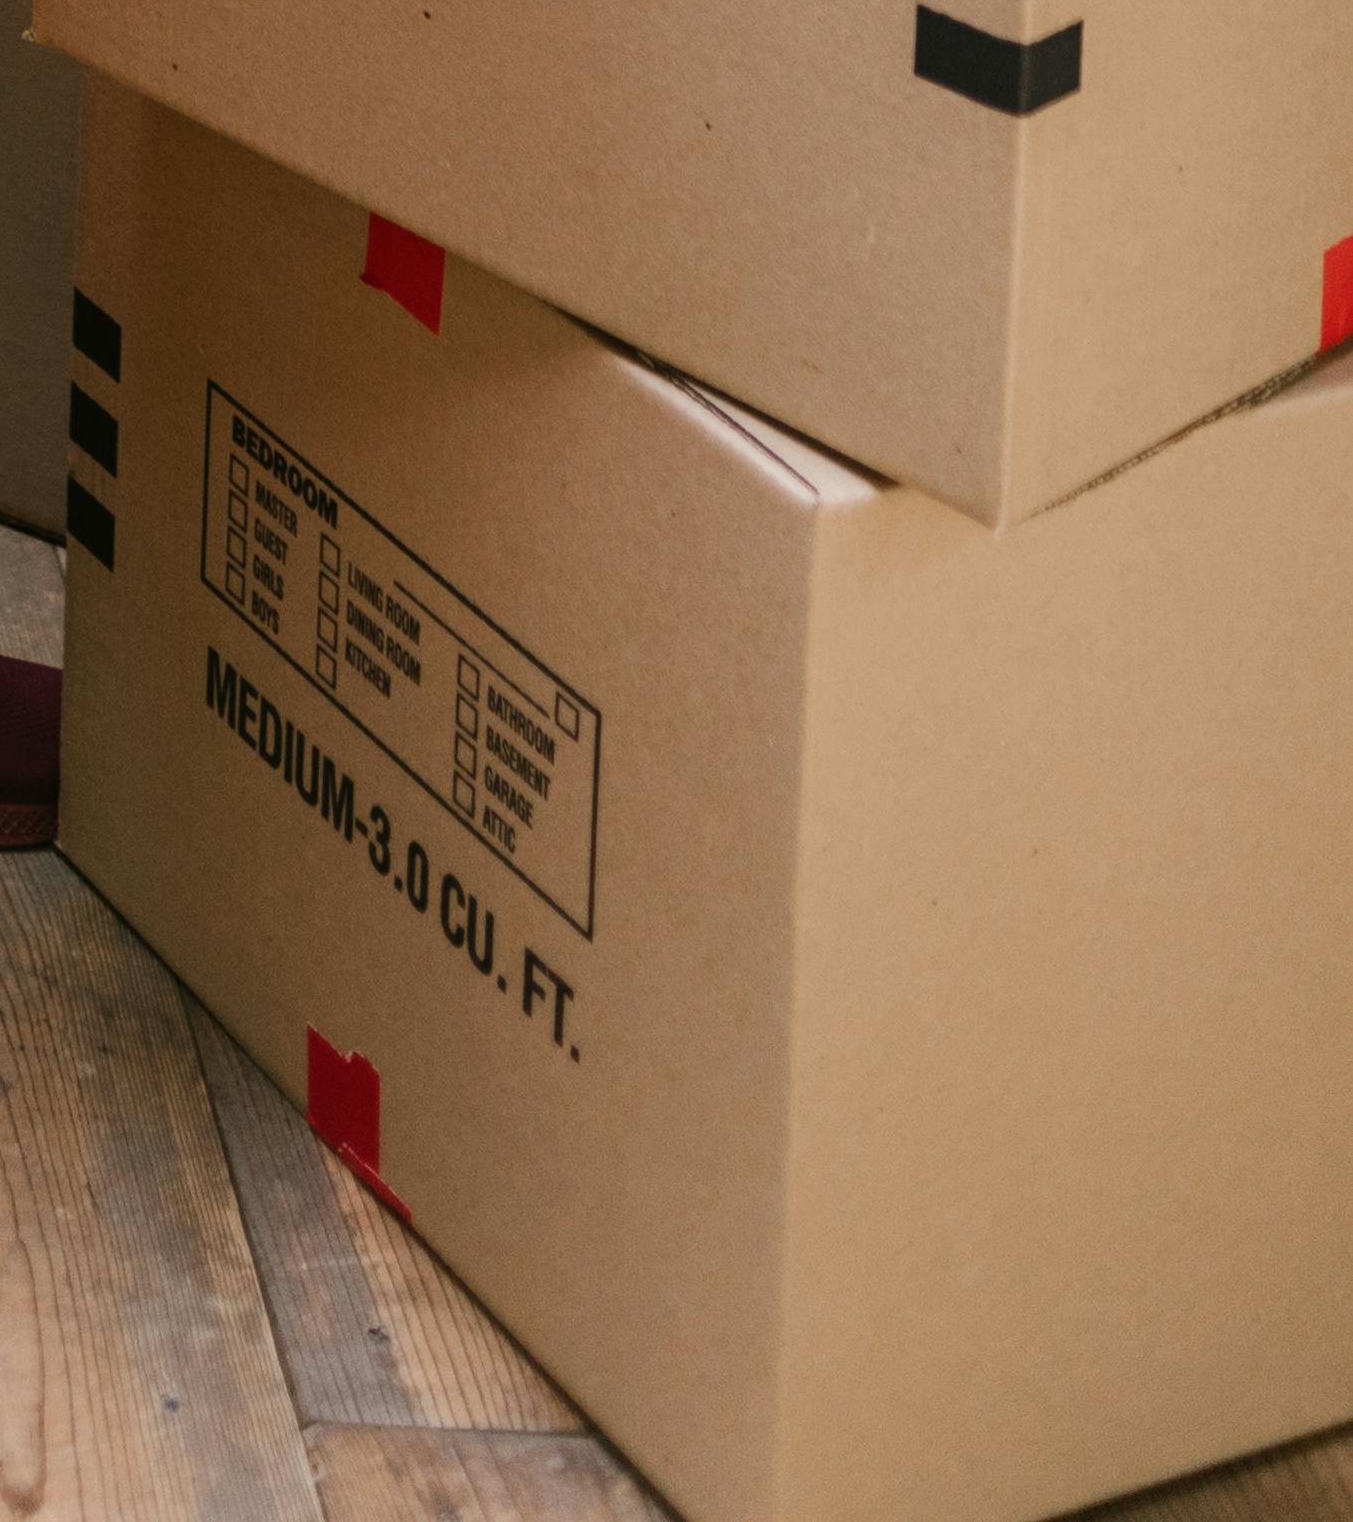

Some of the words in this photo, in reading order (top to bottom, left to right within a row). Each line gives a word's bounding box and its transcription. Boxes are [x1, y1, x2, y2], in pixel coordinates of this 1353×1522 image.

[232, 414, 338, 530] BEDROOM
[254, 517, 288, 565] GUEST
[255, 480, 297, 538] MASTER
[253, 554, 284, 601] GIRLS
[348, 561, 383, 613] LIVING
[386, 594, 421, 646] ROOM
[251, 590, 280, 635] BOYS
[346, 600, 384, 655] DINING
[386, 635, 421, 687] ROOM
[345, 637, 391, 700] KITCHEN
[488, 684, 555, 766] BATHROOM
[486, 724, 551, 801] BASEMENT
[482, 805, 516, 854] ATTIC
[484, 763, 534, 830] GARAGE
[206, 645, 429, 914] MEDIUM-3.0
[440, 873, 507, 994] CU.
[522, 946, 581, 1064] FT.
